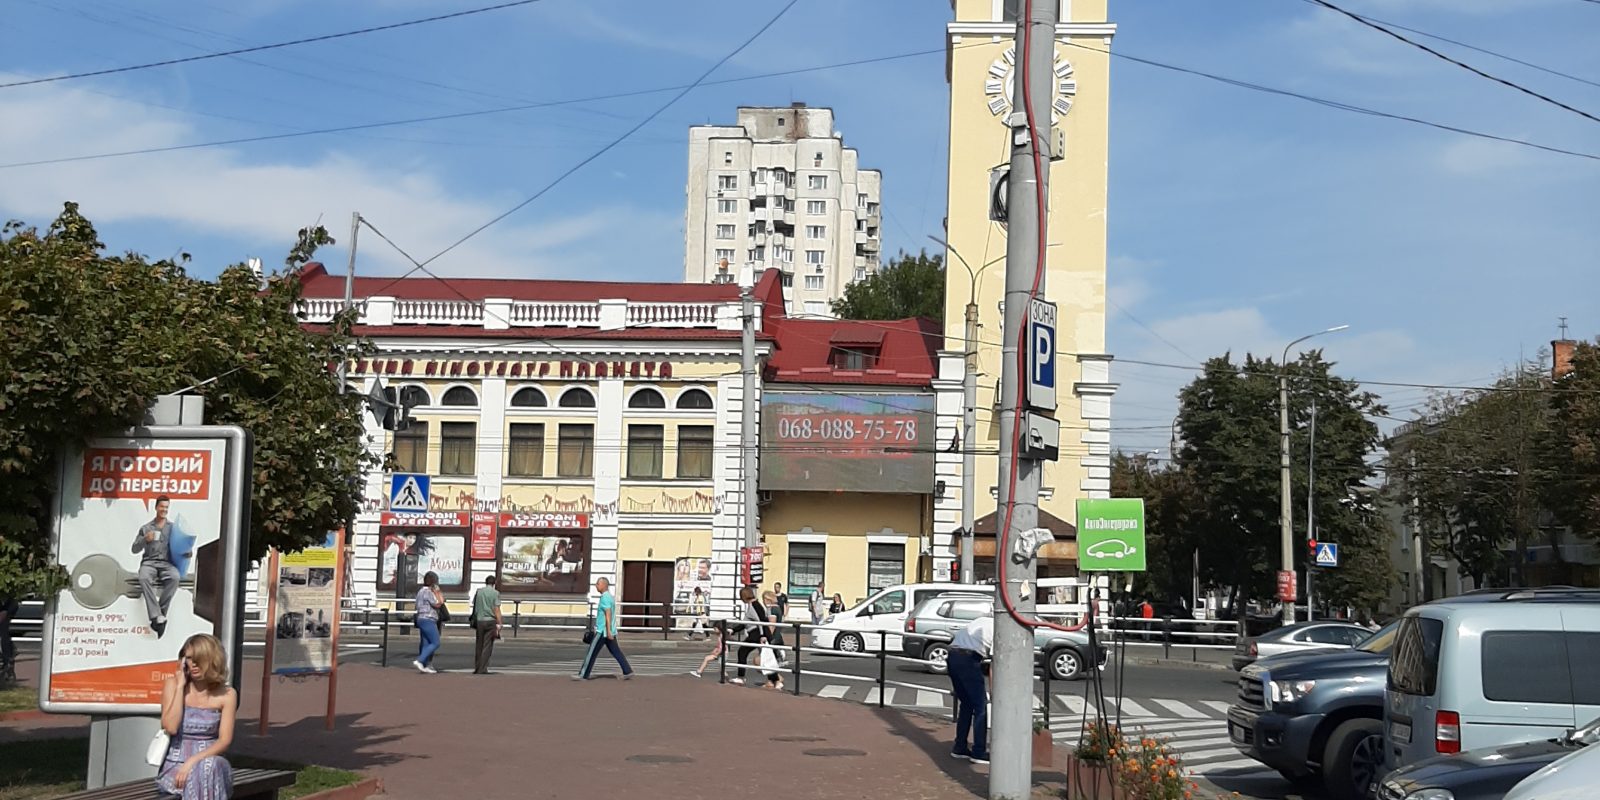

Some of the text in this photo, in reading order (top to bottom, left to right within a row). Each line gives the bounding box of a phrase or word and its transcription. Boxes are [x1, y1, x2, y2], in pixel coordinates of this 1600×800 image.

[1033, 302, 1055, 326] ЗОНА
[1036, 326, 1051, 382] P
[426, 359, 550, 378] КІНОТЕАТР
[560, 360, 673, 379] ПЛАНЕТА
[778, 417, 916, 441] 068-088-75-78
[91, 454, 204, 473] Я ГОТОВИЙ
[89, 475, 203, 495] ДО ПЕРЕЇЗДУ
[61, 613, 94, 622] іпотека
[60, 625, 95, 635] перший
[131, 626, 151, 635] 40%
[59, 637, 71, 645] до
[100, 638, 115, 646] грн
[58, 647, 109, 658] до 20 років
